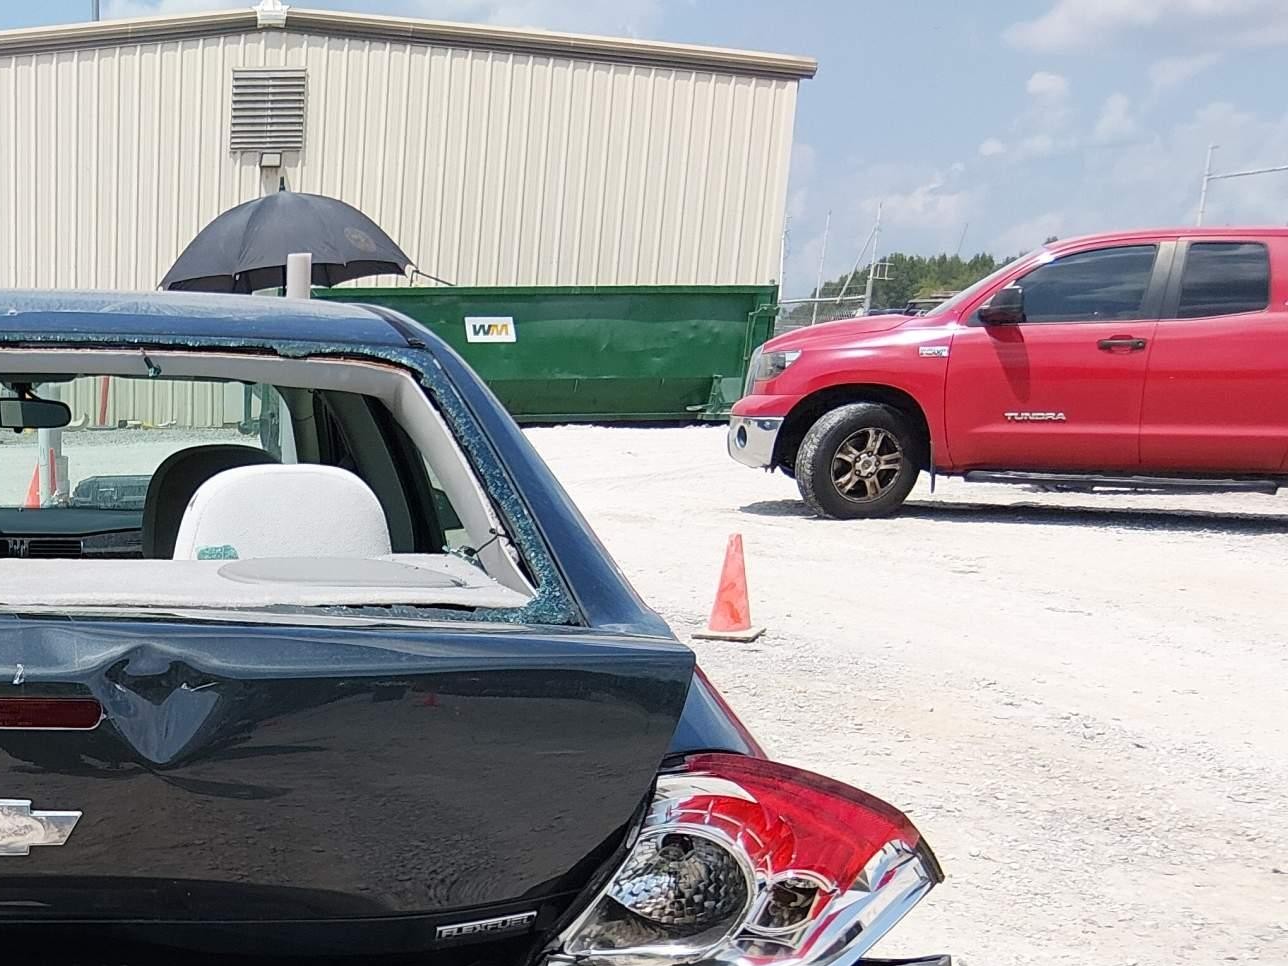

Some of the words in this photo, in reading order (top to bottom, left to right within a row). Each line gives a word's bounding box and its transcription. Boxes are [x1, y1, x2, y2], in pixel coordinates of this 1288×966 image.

[472, 324, 509, 336] WM
[1004, 412, 1067, 422] TUNDRA
[440, 914, 533, 939] FLEXFUEL
